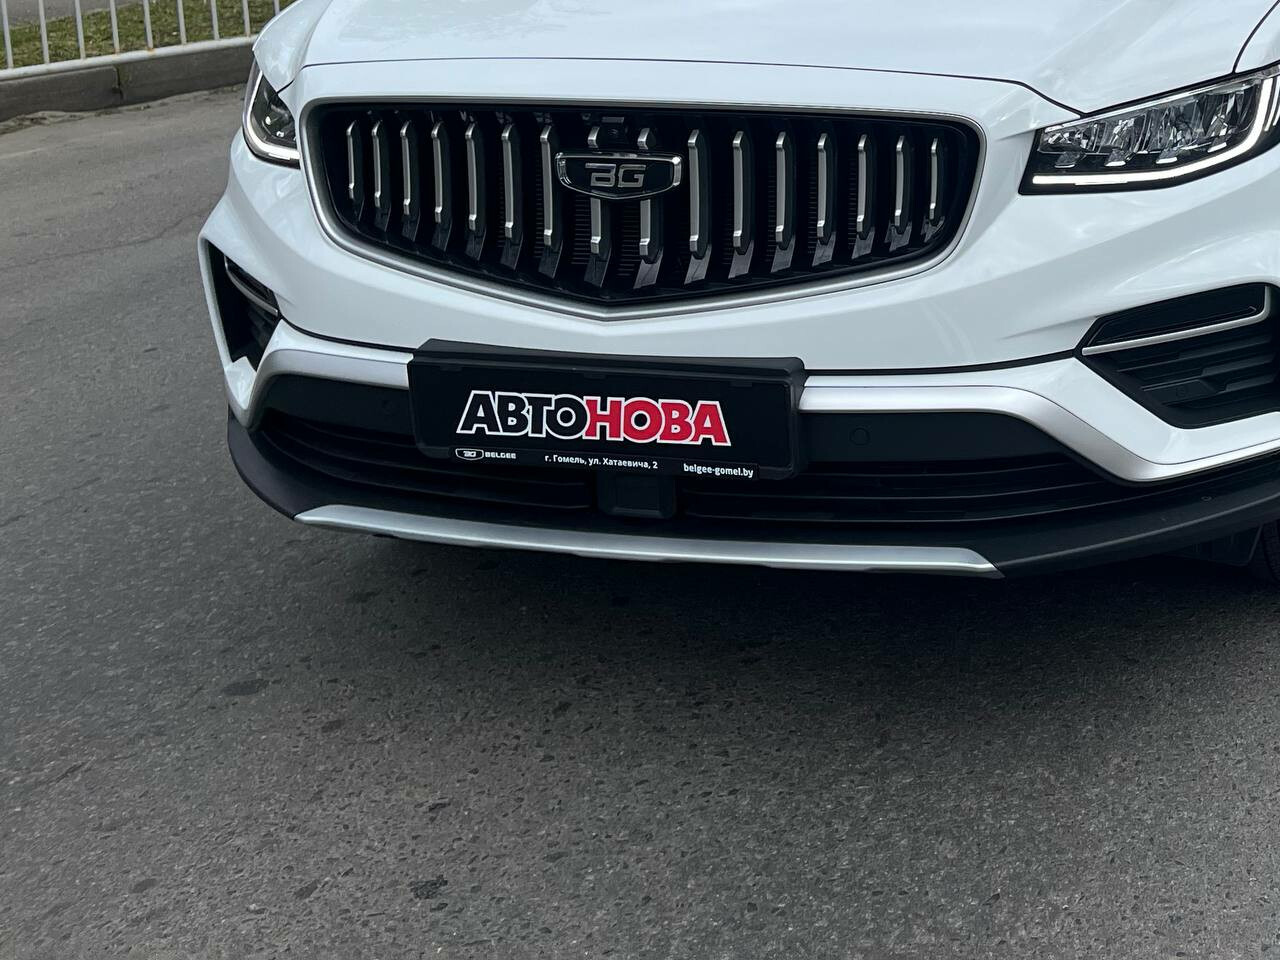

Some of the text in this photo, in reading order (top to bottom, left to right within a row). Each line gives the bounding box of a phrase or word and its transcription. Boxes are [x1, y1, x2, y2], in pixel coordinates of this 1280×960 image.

[456, 390, 732, 447] АВТОНОВА
[544, 454, 658, 469] г. Гомель, ул. Хатаевича, 2
[683, 463, 754, 478] belgee-gomel.by
